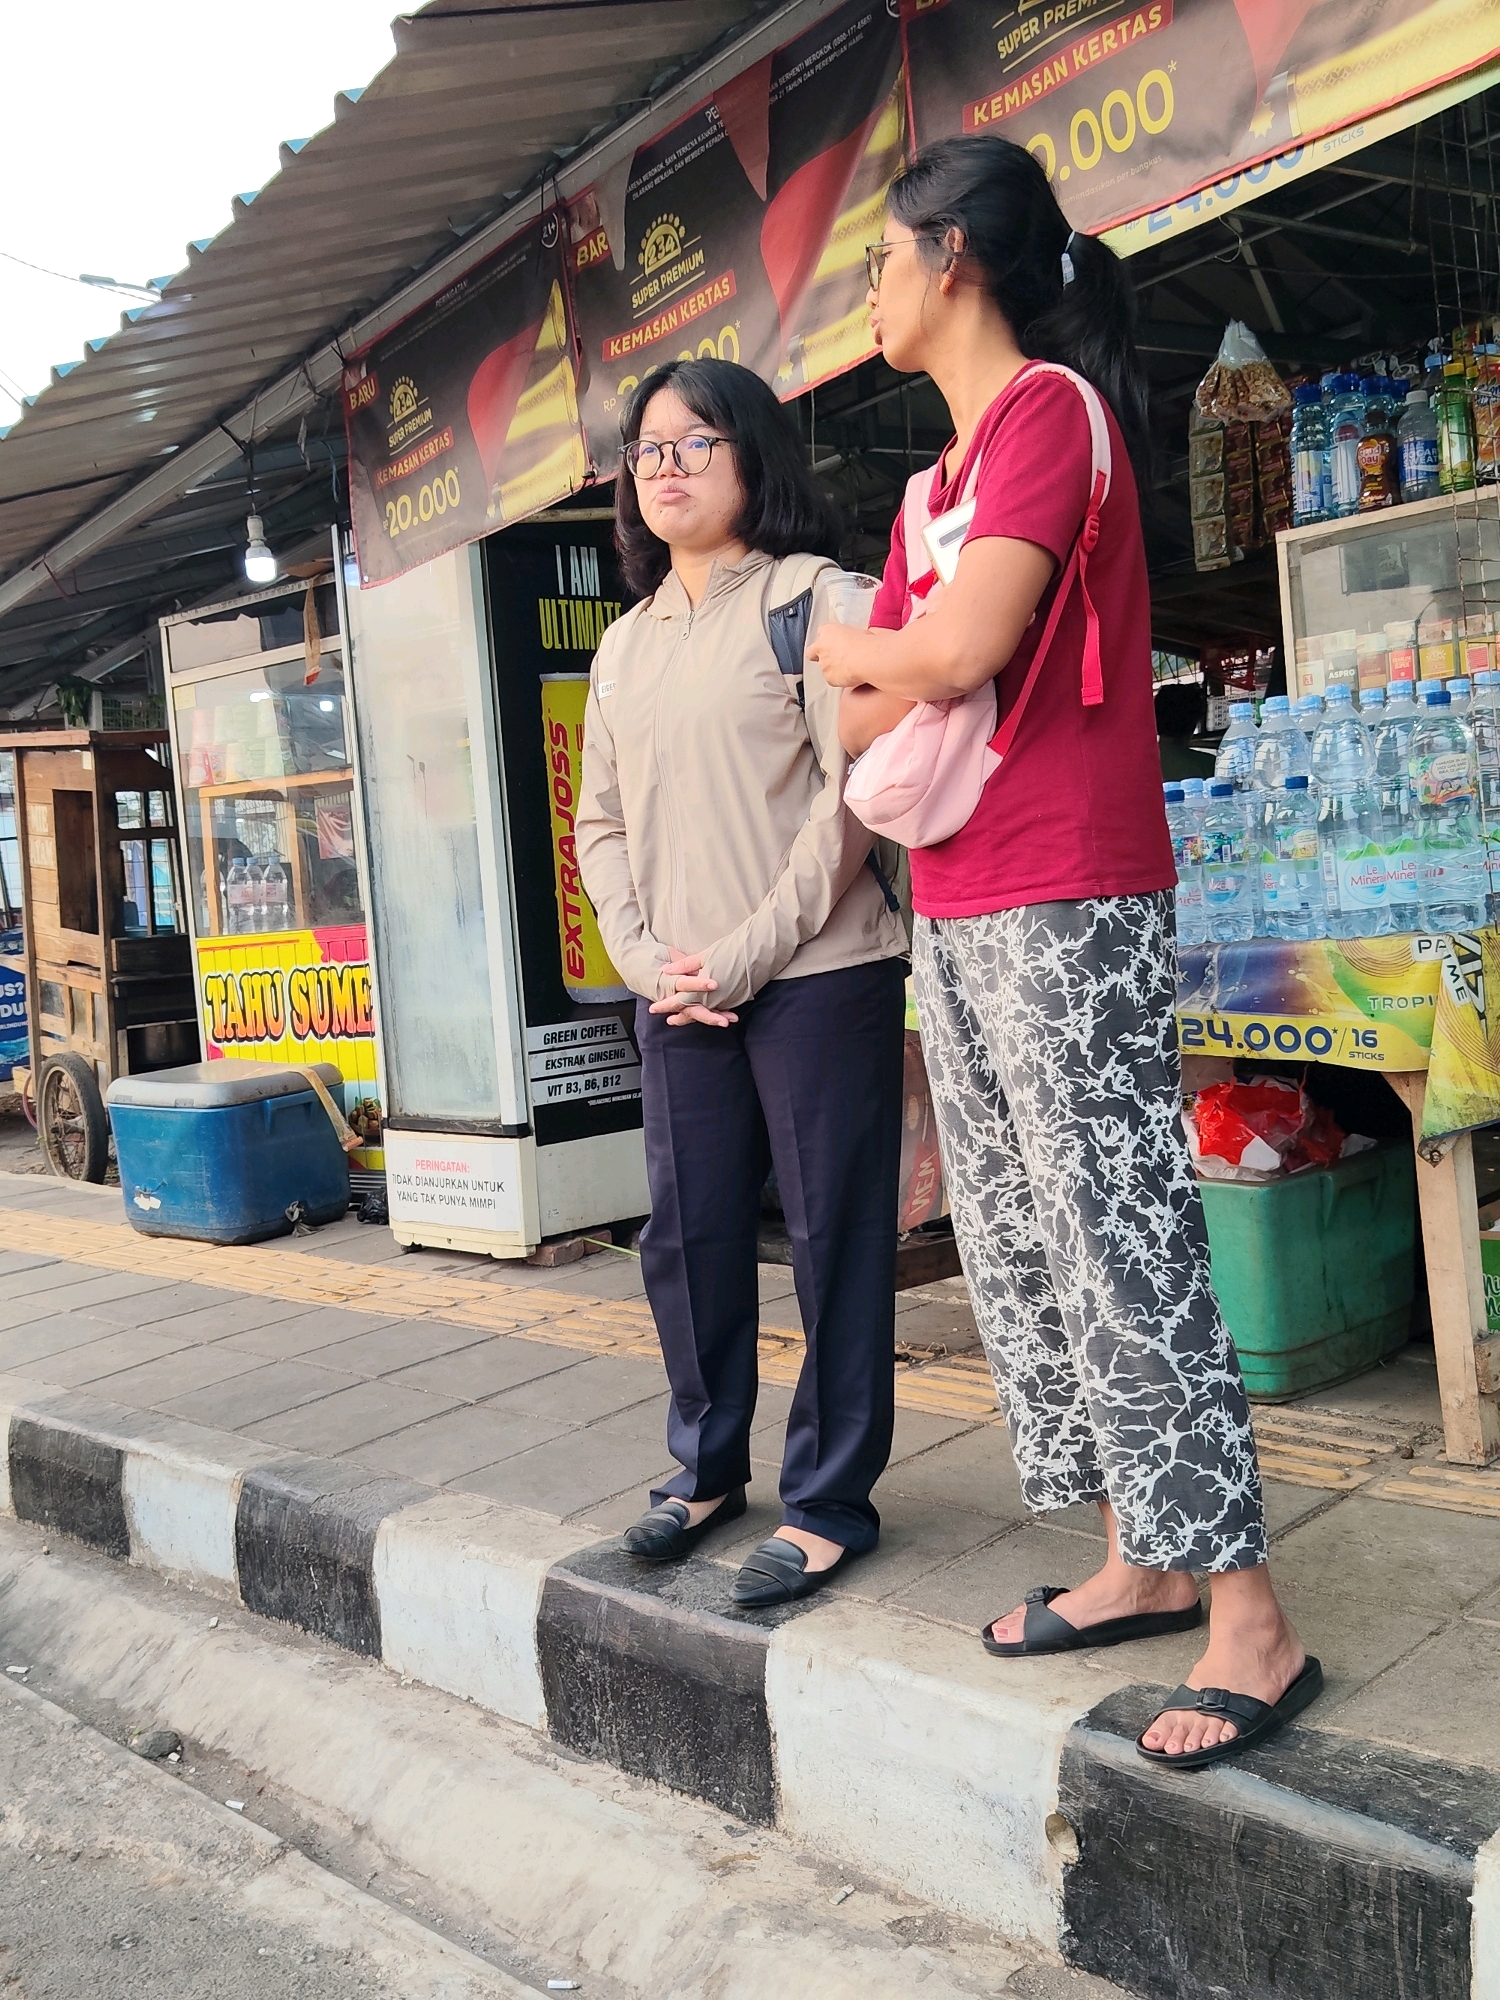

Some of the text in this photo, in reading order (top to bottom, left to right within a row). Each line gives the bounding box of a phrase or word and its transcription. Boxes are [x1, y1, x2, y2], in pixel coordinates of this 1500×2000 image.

[997, 17, 1040, 59] SUPER
[778, 62, 805, 86] BERHENTI
[804, 43, 832, 68] MEROKOK
[973, 5, 1162, 126] KEMASAN KERTAS
[785, 77, 802, 93] TAHUN
[802, 68, 815, 82] DAN
[1323, 127, 1364, 152] STICKS
[1130, 155, 1162, 175] bungkus
[627, 178, 643, 193] ARENA
[576, 231, 609, 267] BAR
[648, 235, 675, 265] 234
[631, 249, 705, 309] SUPER PREMIUM
[610, 277, 730, 357] KEMASAN KERTAS
[350, 378, 376, 410] BARU
[395, 393, 413, 417] 234
[389, 408, 433, 448] SUPER PREMIUM
[376, 432, 450, 485] KEMASAN KERTAS
[555, 545, 600, 596] I AM
[1366, 864, 1378, 875] Le
[1401, 860, 1415, 871] Le
[206, 972, 286, 1042] TAHU
[1369, 995, 1435, 1011] TROPI
[543, 1022, 618, 1046] GREEN COFFEE
[1351, 1028, 1378, 1049] 16
[545, 1048, 626, 1071] EKSTRAK GINSENG
[1348, 1051, 1385, 1062] STICKS
[547, 1074, 621, 1098] VIT B3, B6, B12
[415, 1158, 470, 1174] PERINGATAN:
[392, 1173, 505, 1193] TIDAK DIANJURKAN UNTUK
[396, 1190, 496, 1211] YANG TAK PUNYA MIMPI
